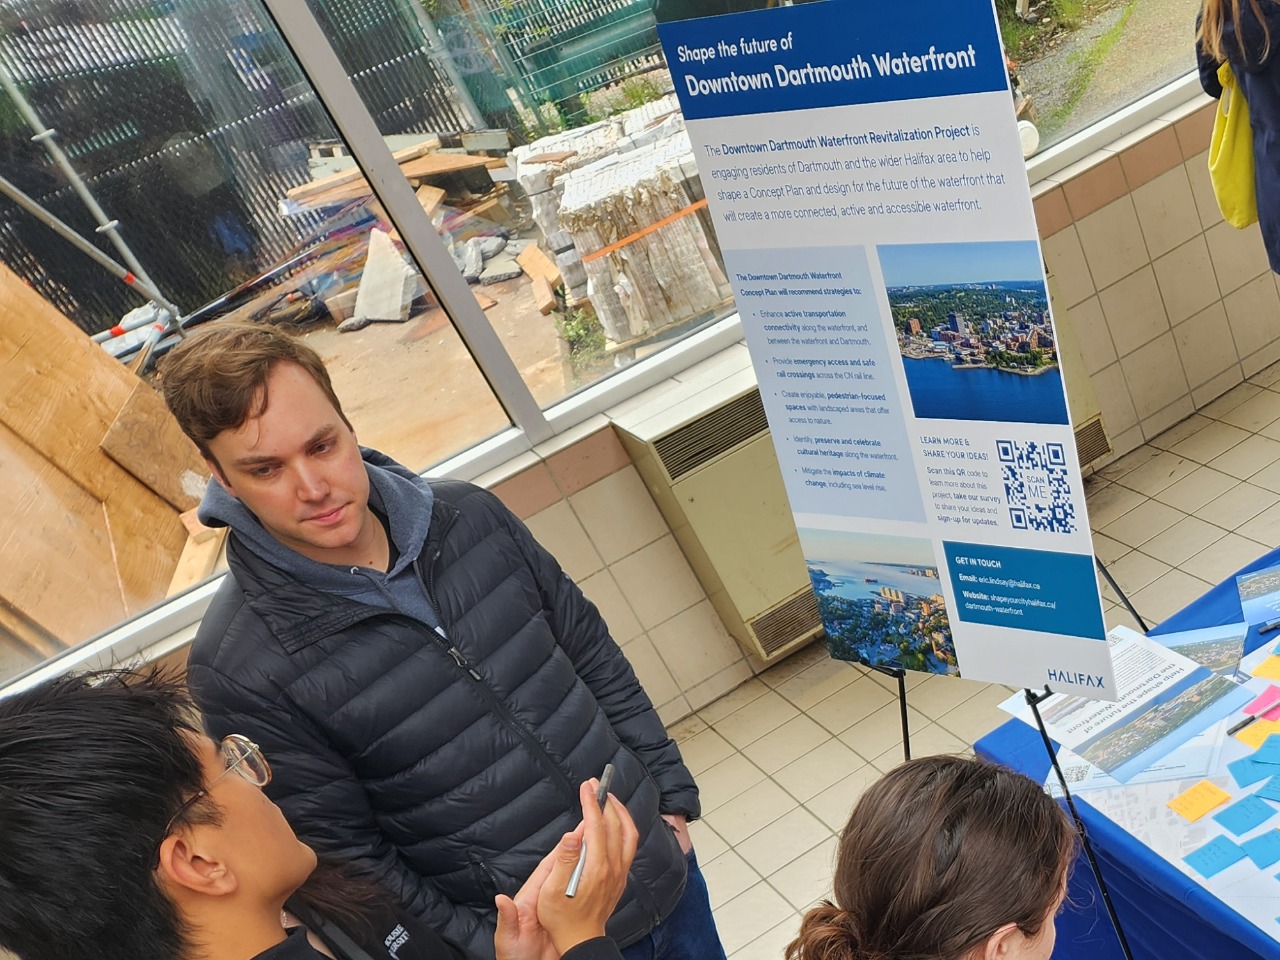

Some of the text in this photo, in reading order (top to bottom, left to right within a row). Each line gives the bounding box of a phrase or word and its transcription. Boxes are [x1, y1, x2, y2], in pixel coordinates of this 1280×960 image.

[677, 31, 793, 65] Shape the future of
[685, 45, 976, 97] Downtown Dartmouth Waterfront
[704, 124, 981, 157] The Downtown Dartmouth Waterfront Revitalization Project is
[712, 148, 991, 180] engaging residents of Dartmouth and the wider Halifax area to help
[718, 173, 1006, 202] shape a Concept Plan and design for the future of the waterfront that
[723, 199, 982, 222] will create a more connected, active and accessible waterfront.
[748, 273, 778, 281] Downtown
[779, 272, 810, 280] Dartmouth
[811, 272, 842, 280] Waterfront
[740, 289, 765, 298] Concept
[789, 288, 823, 296] recommend
[824, 288, 853, 297] strategies
[760, 310, 846, 319] Enhance active transportation
[773, 357, 793, 366] Provide
[794, 359, 827, 367] emergency
[862, 359, 876, 367] safe
[920, 437, 942, 445] LEARN
[943, 438, 963, 446] MORE
[923, 450, 989, 461] SHARE YOUR IDEAS!
[927, 467, 988, 478] Scan this QR code to
[1026, 476, 1045, 484] SCAN
[1029, 486, 1048, 499] ME
[956, 556, 1001, 569] GET IN TOUCH
[959, 573, 978, 583] Email:
[962, 590, 990, 601] Website:
[1047, 669, 1106, 689] HALIFAX
